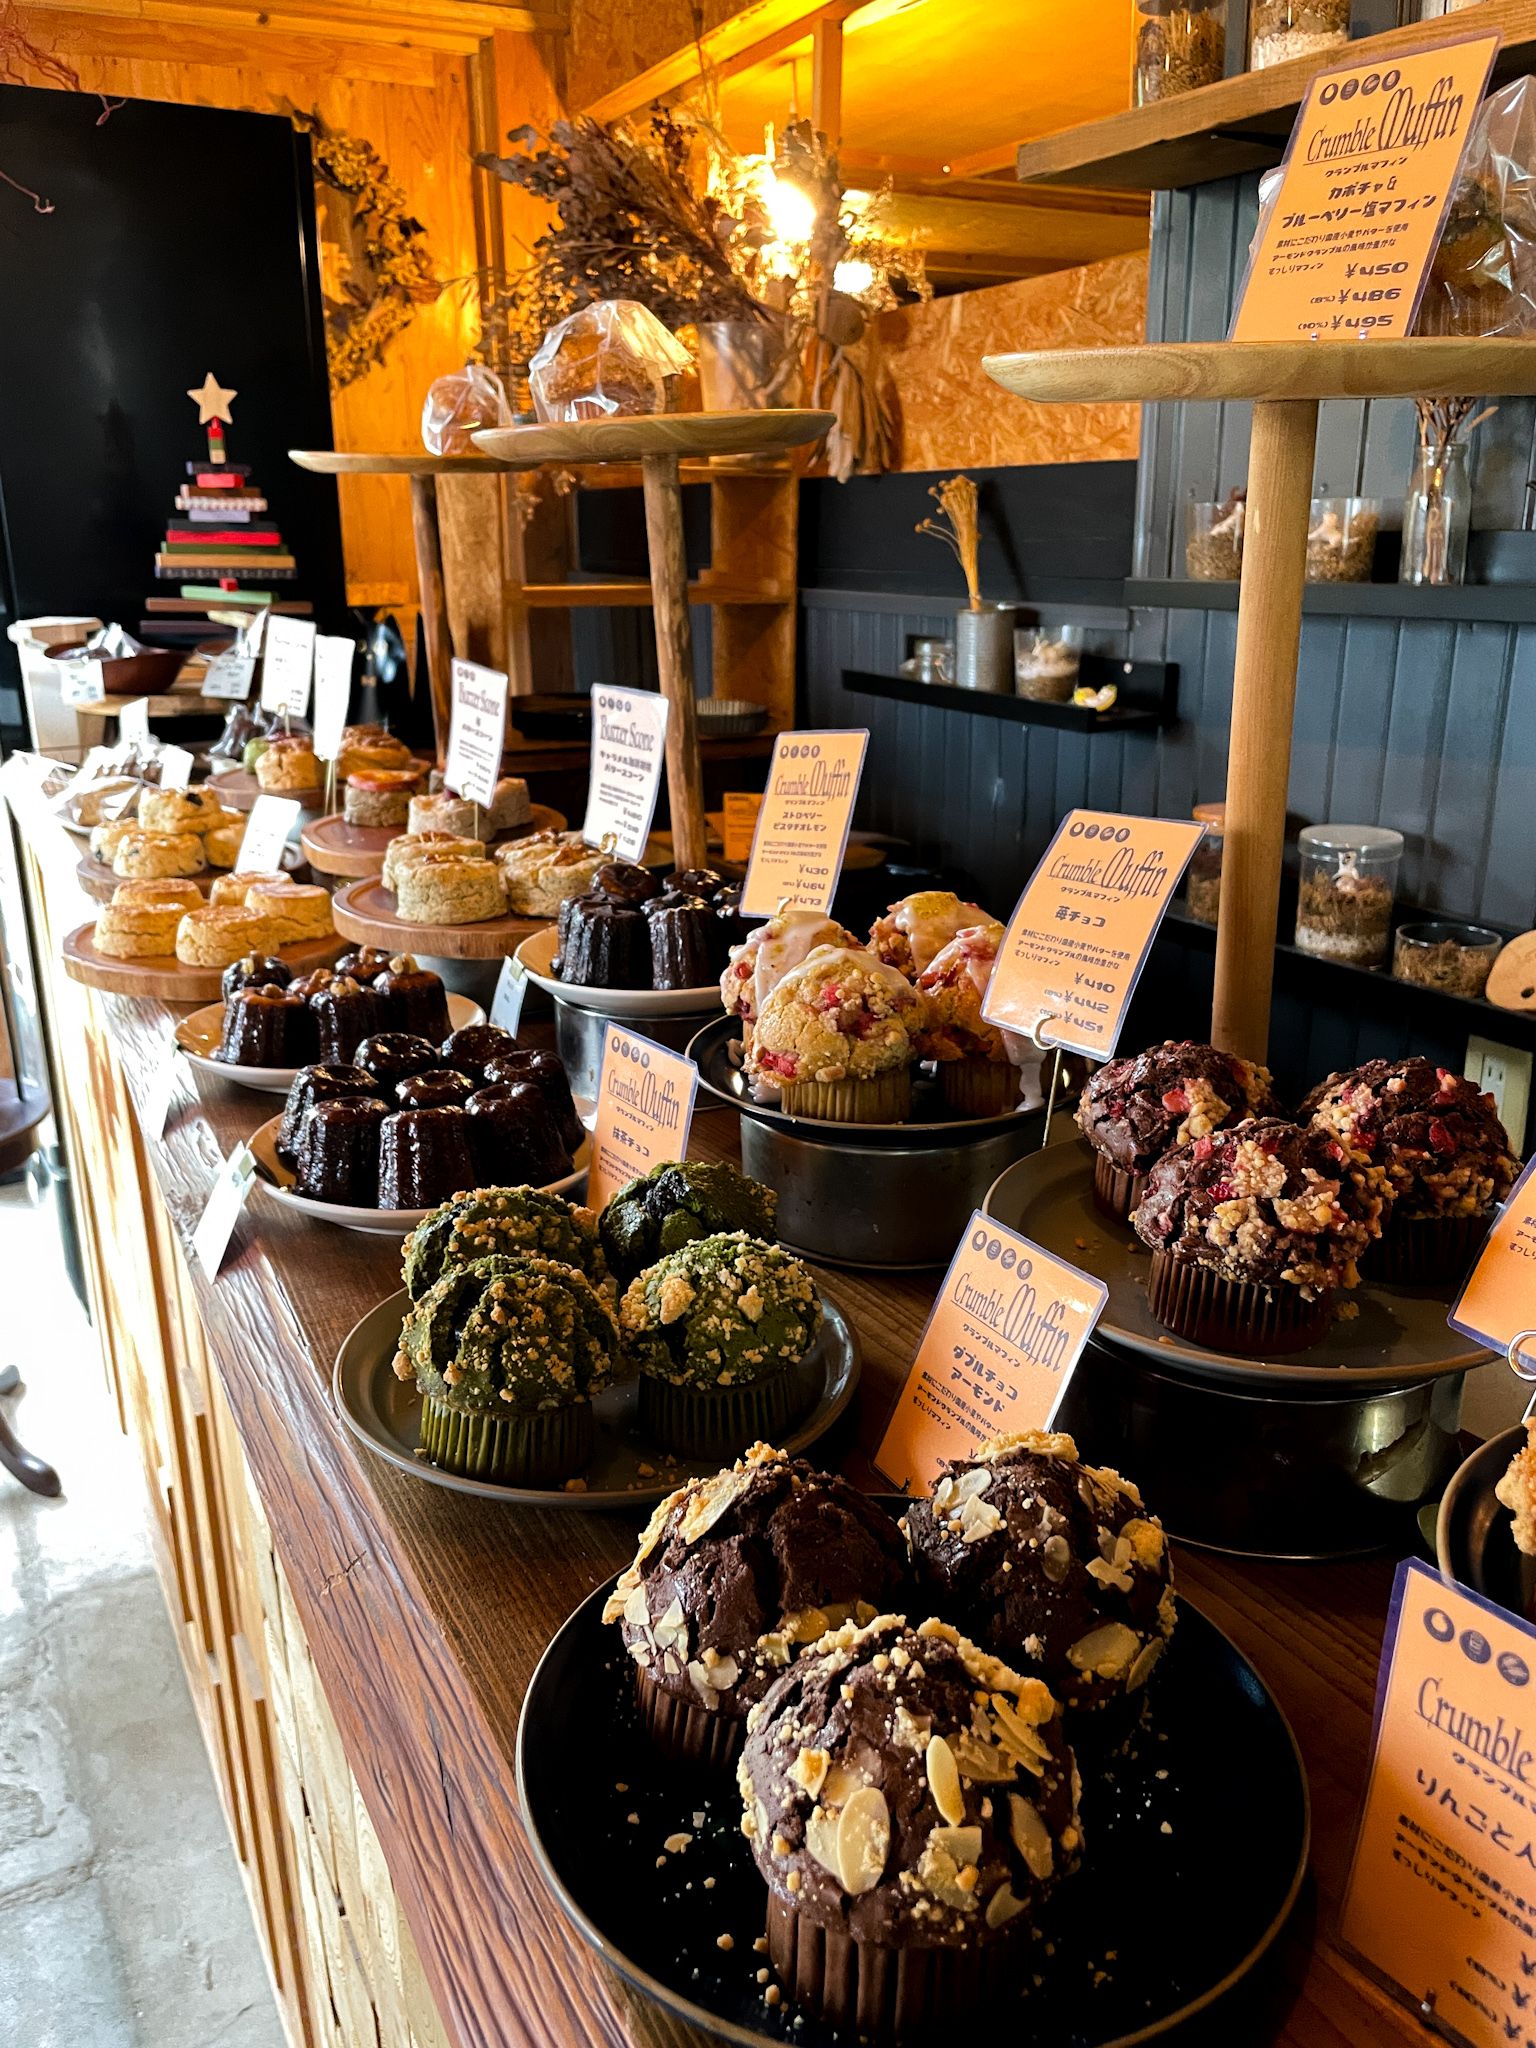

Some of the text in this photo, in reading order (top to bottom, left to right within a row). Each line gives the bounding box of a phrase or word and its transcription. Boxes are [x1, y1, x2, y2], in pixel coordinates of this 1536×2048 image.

[1307, 75, 1464, 162] Crumble Muffin
[1324, 157, 1408, 178] クランブルマフィン
[1282, 195, 1437, 229] ブルーベリー塩マフィン
[775, 759, 851, 800] Crumble Muffin
[1050, 847, 1167, 900] Crumble Muffin
[1061, 886, 1121, 903] クランブルマフィン
[1055, 905, 1106, 928] 苺チョコ
[608, 1069, 680, 1131] Crumble Muffin
[613, 1125, 650, 1157] 抹茶チョコ
[954, 1272, 1069, 1372] Crumble Muffin
[962, 1323, 1021, 1367] クランブルマフィン
[950, 1367, 1005, 1413] アーモンド
[953, 1345, 1018, 1400] ダブルチョコ
[1418, 1677, 1533, 1782] Crumble
